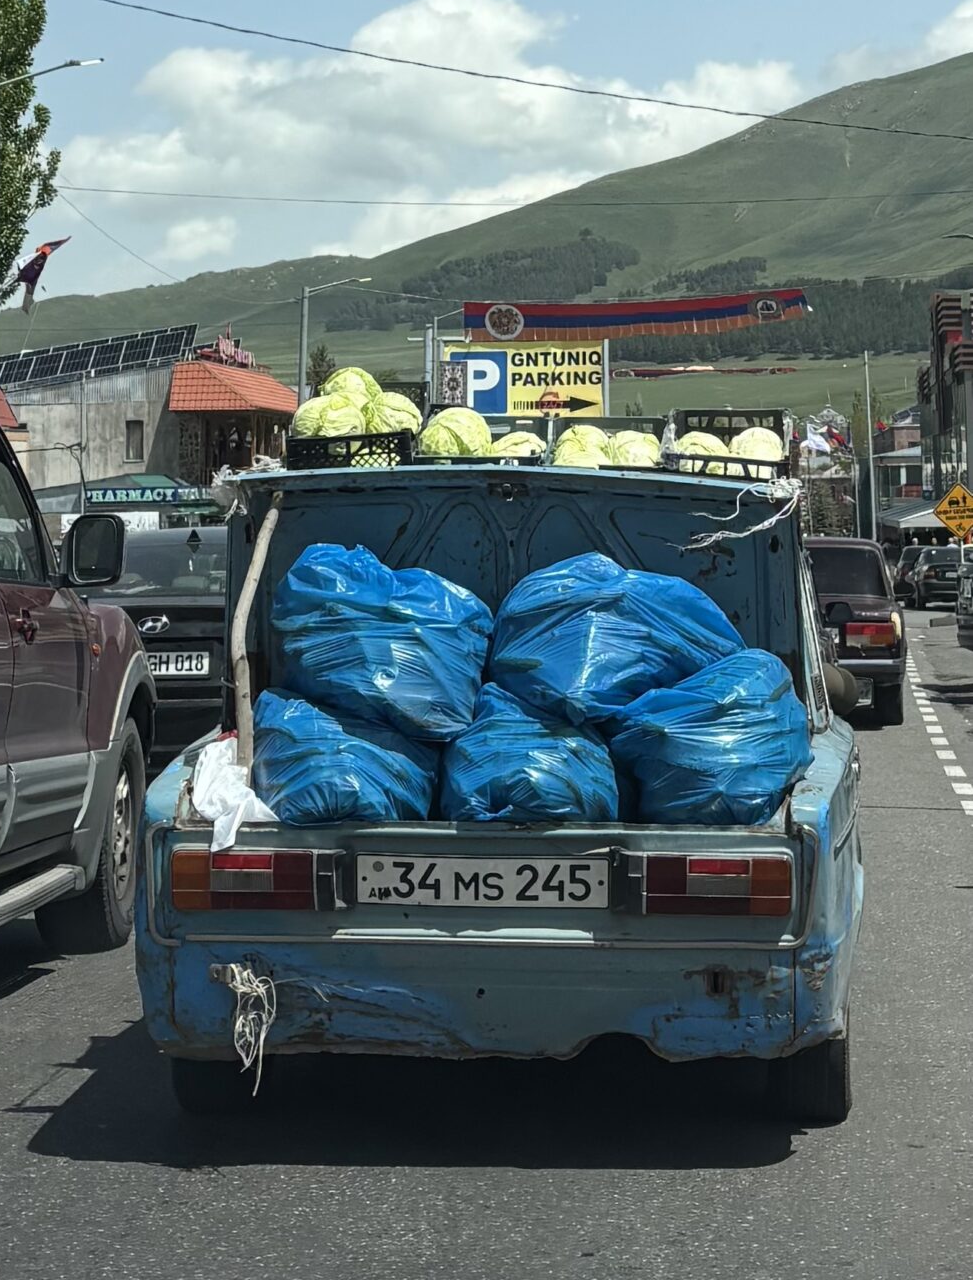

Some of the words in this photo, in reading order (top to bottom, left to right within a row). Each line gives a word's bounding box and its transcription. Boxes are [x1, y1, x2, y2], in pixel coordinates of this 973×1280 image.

[511, 351, 602, 367] GNTUNIQ
[511, 371, 602, 386] PARKING
[175, 653, 204, 672] 018
[392, 861, 441, 900] 34
[454, 871, 504, 901] MS
[515, 864, 591, 902] 245
